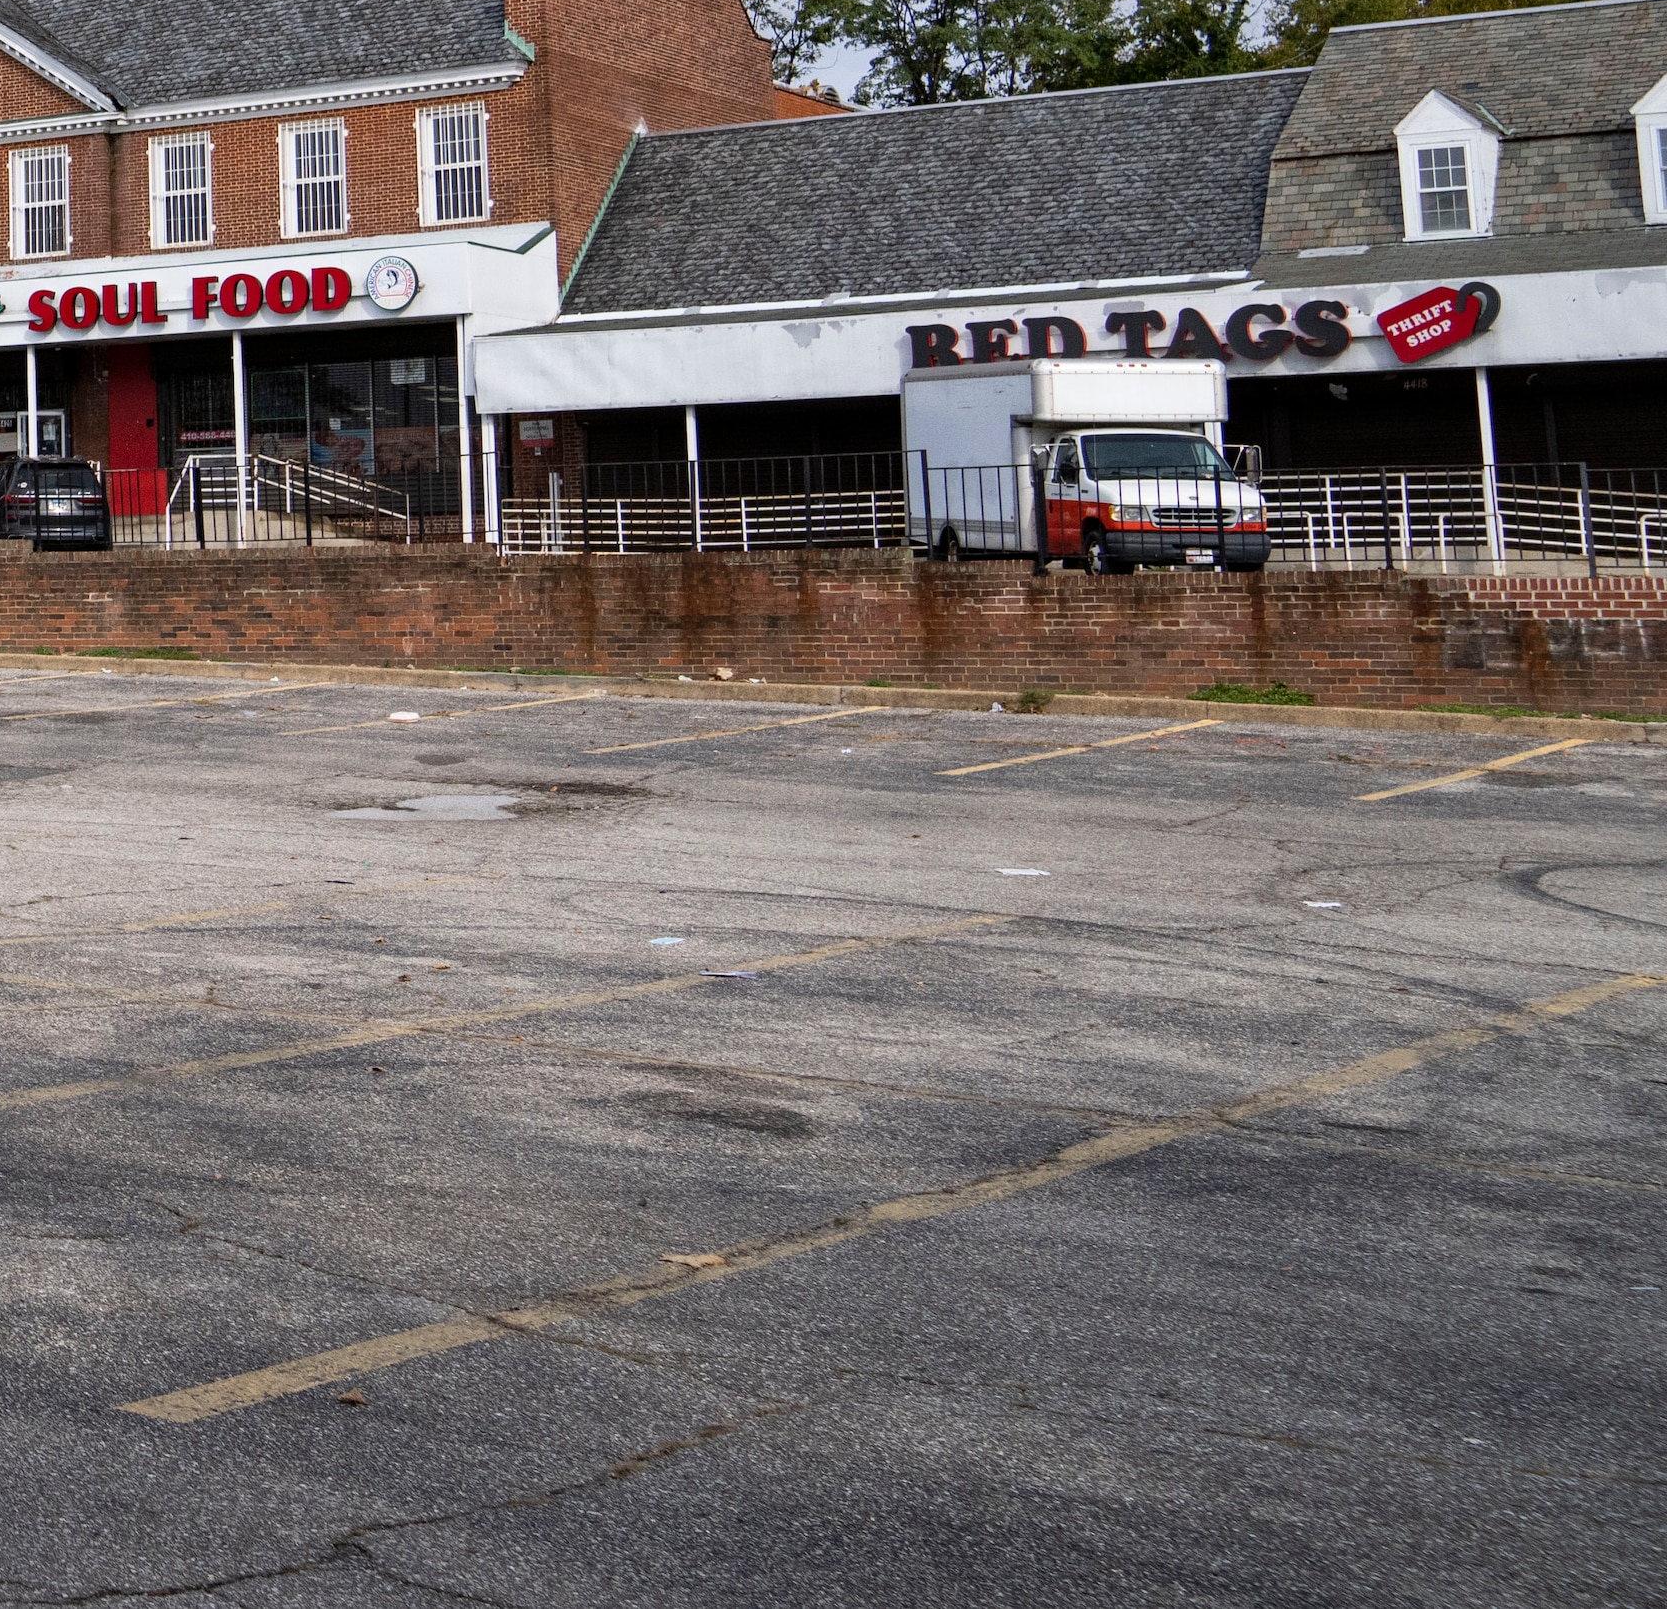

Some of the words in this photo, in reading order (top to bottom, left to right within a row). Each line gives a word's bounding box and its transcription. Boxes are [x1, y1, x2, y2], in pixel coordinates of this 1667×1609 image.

[382, 258, 407, 270] ITALIAN
[28, 281, 168, 332] SOUL
[192, 267, 352, 319] FOOD
[905, 316, 1088, 368] RED
[1104, 300, 1354, 360] TAGS
[1387, 299, 1453, 337] THRIFT
[1406, 319, 1452, 348] SHOP
[1403, 378, 1428, 390] 4418
